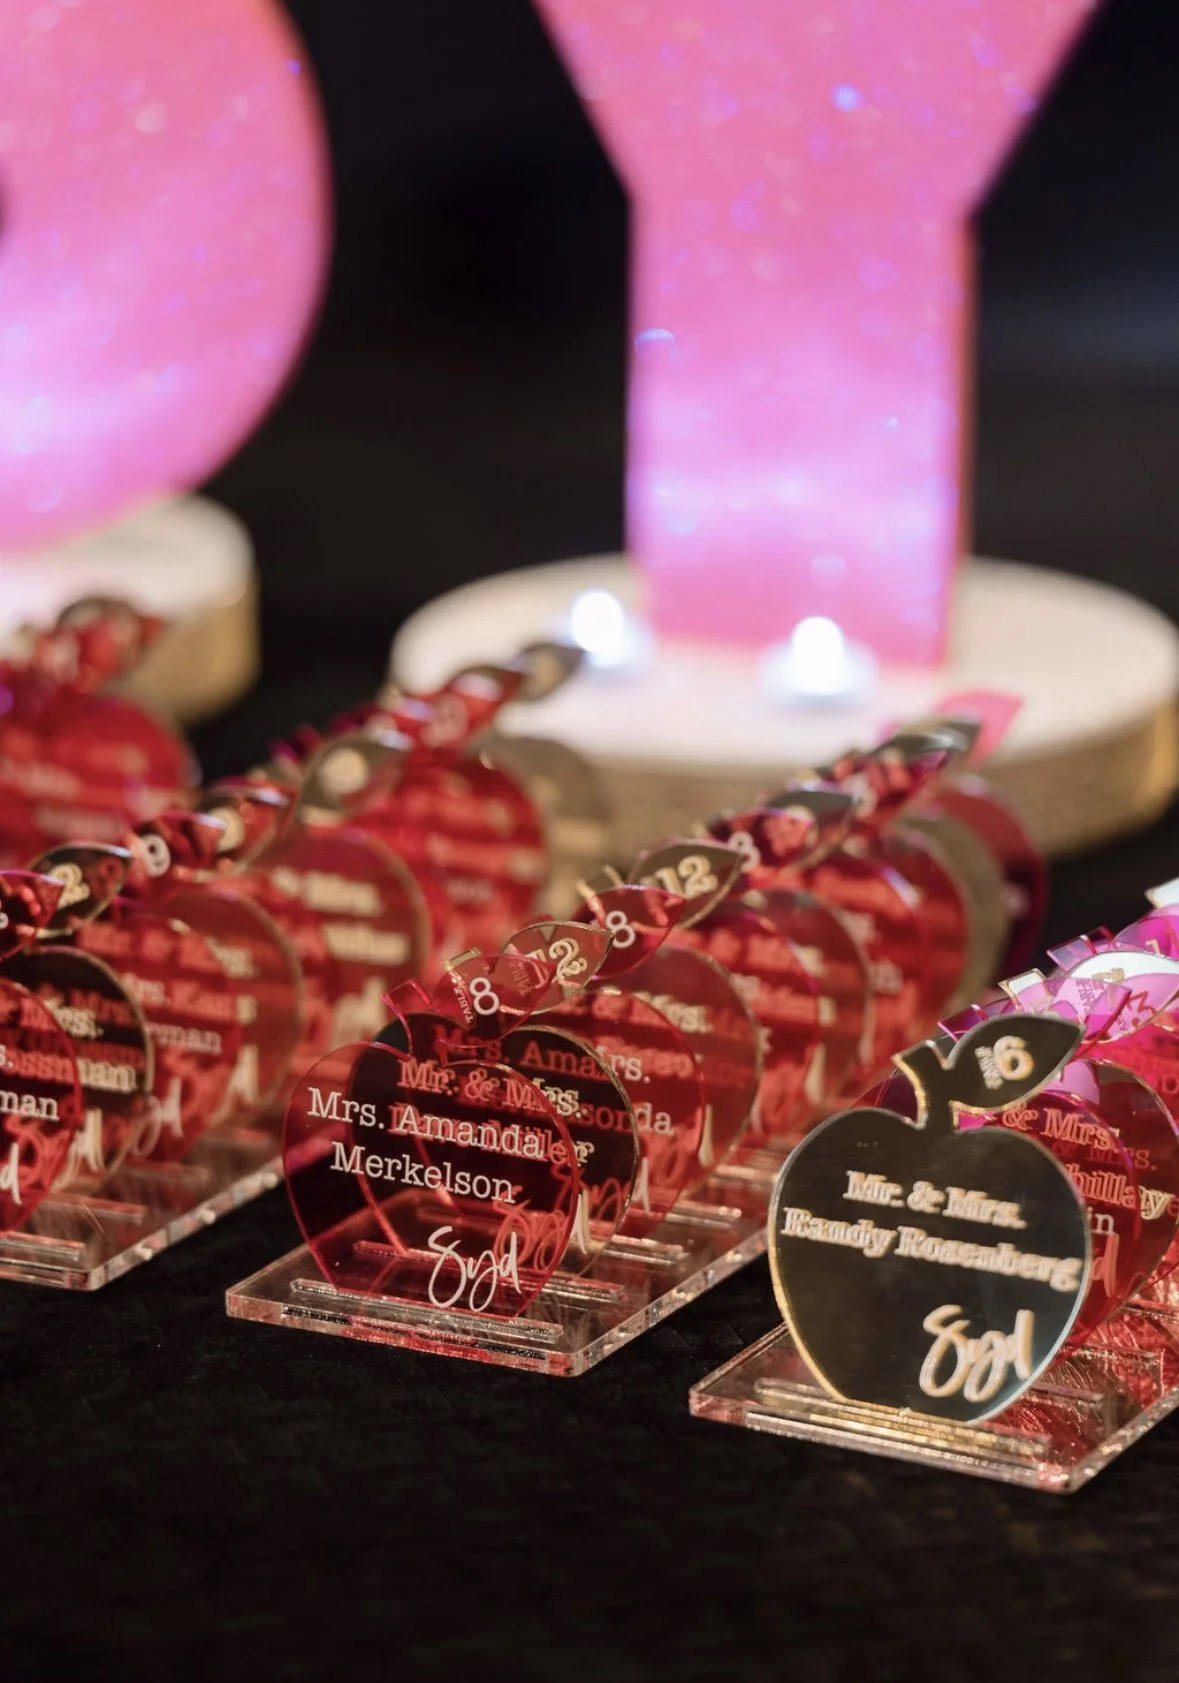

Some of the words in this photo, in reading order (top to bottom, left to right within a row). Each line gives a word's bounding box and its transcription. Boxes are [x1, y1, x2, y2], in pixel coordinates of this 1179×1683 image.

[605, 911, 636, 949] 8
[469, 977, 500, 1015] 8
[993, 1035, 1035, 1081] 6
[307, 1086, 385, 1130] Mrs.
[398, 1104, 548, 1161] Amanda
[330, 1140, 517, 1204] Merkelson
[842, 1169, 904, 1206] Mr.
[904, 1179, 945, 1214] &
[941, 1185, 1028, 1229] Mrs.
[427, 1225, 523, 1312] Syd
[918, 1303, 1036, 1402] Syd
